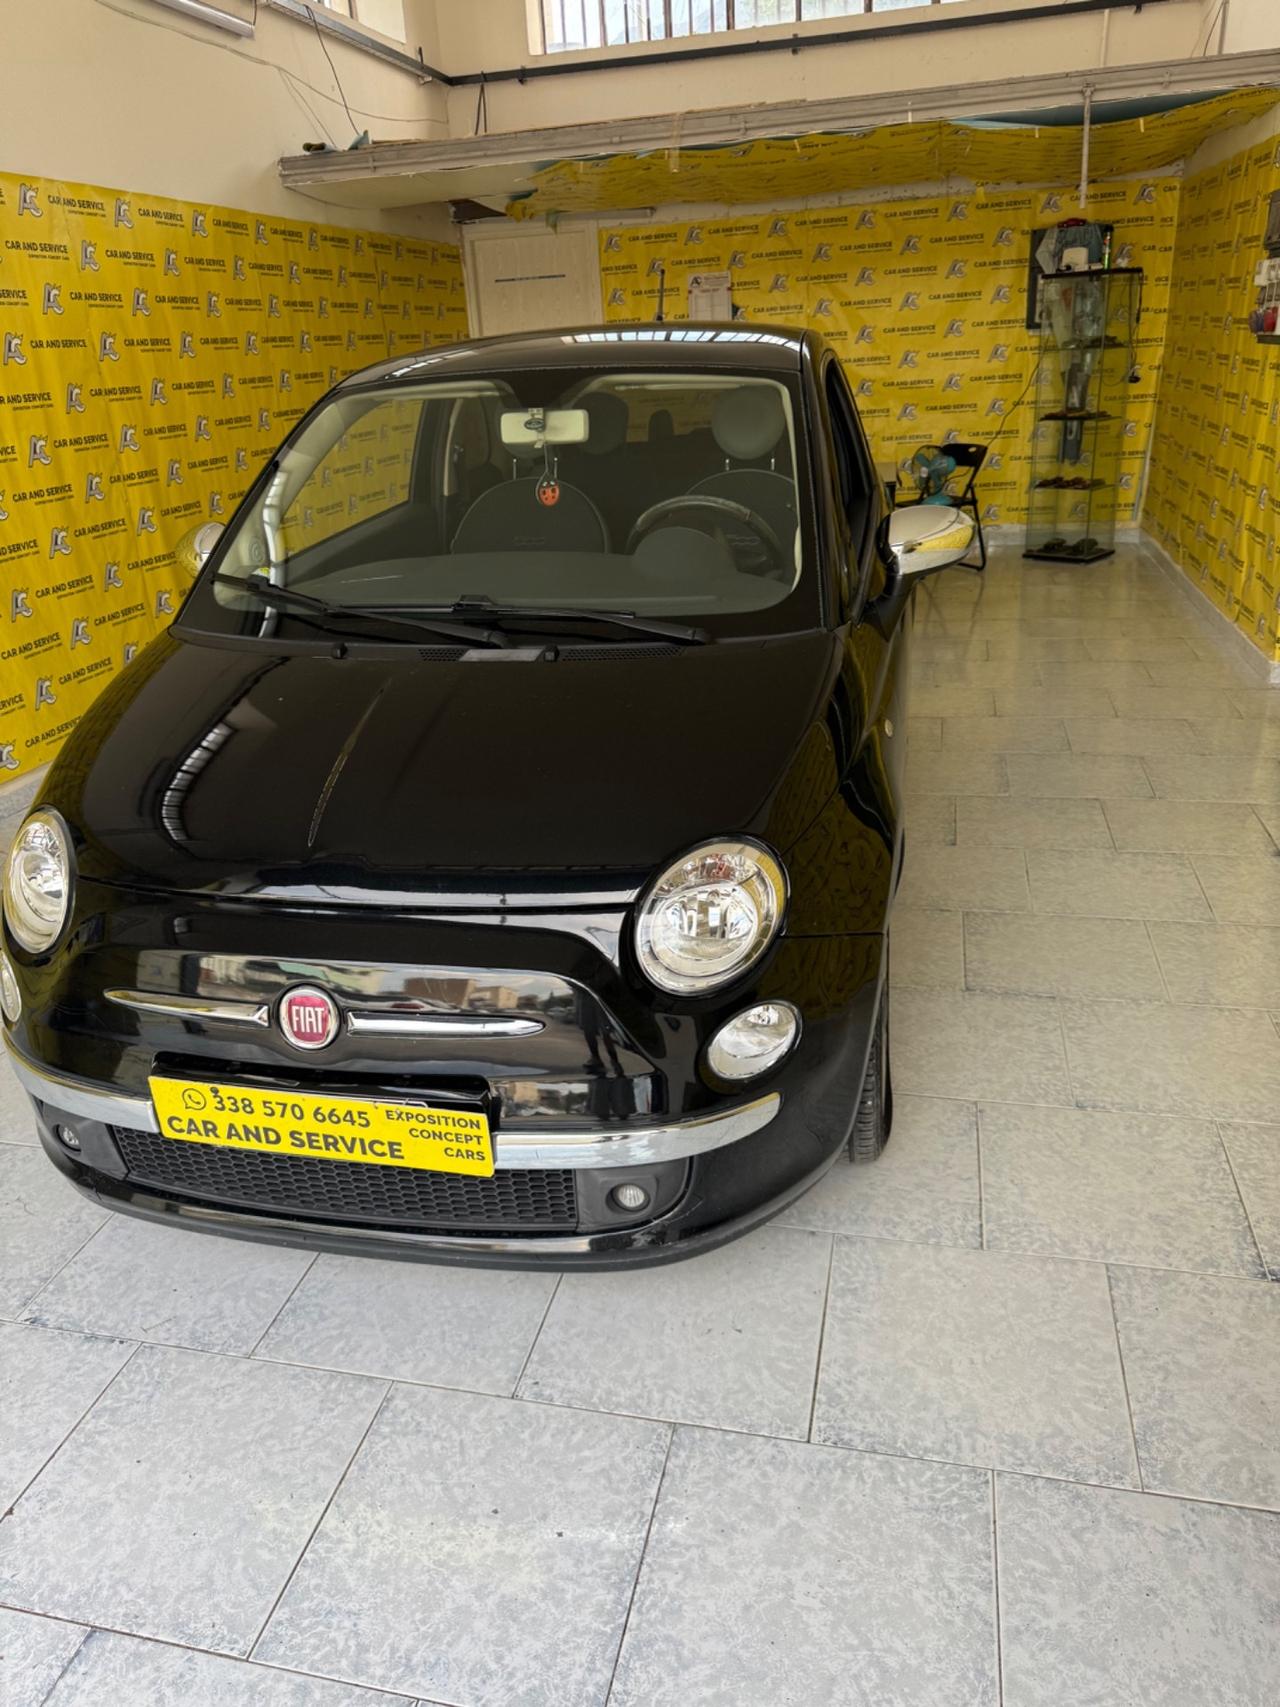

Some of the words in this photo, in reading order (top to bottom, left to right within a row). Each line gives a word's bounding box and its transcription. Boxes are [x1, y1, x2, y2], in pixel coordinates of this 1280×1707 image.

[48, 195, 62, 205] CAR
[62, 197, 76, 208] AND
[77, 199, 105, 211] SERVICE
[976, 202, 989, 210] CAR
[1005, 199, 1031, 207] SERVICE
[138, 208, 150, 217] CAR
[152, 210, 162, 219] AND
[163, 211, 183, 222] SERVICE
[823, 216, 848, 224] SERVICE
[884, 211, 897, 219] CAR
[735, 224, 759, 232] SERVICE
[654, 232, 677, 240] SERVICE
[959, 233, 984, 241] SERVICE
[5, 240, 20, 250] CAR
[23, 242, 38, 251] AND
[39, 243, 68, 254] SERVICE
[868, 241, 892, 249] SERVICE
[105, 249, 117, 258] CAR
[119, 250, 131, 260] AND
[132, 251, 154, 261] SERVICE
[697, 256, 721, 264] SERVICE
[70, 291, 82, 301] CAR
[84, 292, 97, 301] AND
[98, 293, 122, 302] SERVICE
[155, 295, 166, 304] CAR
[167, 296, 178, 304] AND
[179, 296, 199, 304] SERVICE
[867, 297, 891, 305] SERVICE
[30, 340, 43, 349] CAR
[46, 340, 60, 348] AND
[62, 339, 87, 348] SERVICE
[124, 338, 136, 347] CAR
[136, 338, 149, 347] AND
[150, 338, 171, 346] SERVICE
[90, 388, 102, 397] CAR
[104, 387, 117, 396] AND
[118, 385, 142, 395] SERVICE
[172, 383, 183, 391] CAR
[184, 382, 195, 390] AND
[196, 380, 214, 389] SERVICE
[7, 394, 22, 404] AND
[23, 392, 52, 403] SERVICE
[143, 428, 154, 437] CAR
[155, 426, 166, 435] AND
[167, 423, 186, 433] SERVICE
[54, 438, 68, 449] CAR
[69, 437, 82, 447] AND
[84, 433, 108, 444] SERVICE
[109, 474, 121, 484] CAR
[123, 472, 136, 482] AND
[137, 468, 158, 480] SERVICE
[12, 492, 27, 503] CAR
[29, 489, 45, 500] AND
[46, 484, 72, 497] SERVICE
[160, 507, 171, 517] CAR
[172, 505, 182, 514] AND
[183, 500, 201, 512] SERVICE
[74, 527, 86, 538] CAR
[87, 524, 100, 535] AND
[101, 517, 126, 531] SERVICE
[8, 539, 38, 554] SERVICE
[127, 560, 140, 571] CAR
[141, 557, 153, 567] AND
[36, 587, 50, 599] CAR
[52, 582, 66, 595] AND
[68, 574, 93, 590] SERVICE
[94, 615, 106, 627] CAR
[107, 610, 120, 622] AND
[121, 602, 144, 617] SERVICE
[1, 647, 17, 661] CAR
[19, 642, 33, 655] AND
[34, 631, 60, 649] SERVICE
[59, 672, 72, 686] CAR
[73, 667, 86, 680] AND
[87, 656, 112, 674] SERVICE
[25, 735, 39, 749] CAR
[42, 727, 56, 742] AND
[292, 1005, 324, 1033] FIAT
[214, 1092, 254, 1115] 338
[262, 1100, 304, 1122] 570
[313, 1106, 370, 1129] 6645
[386, 1109, 481, 1130] EXPOSITION
[168, 1116, 219, 1139] CAR
[226, 1122, 282, 1146] AND
[290, 1129, 404, 1160] SERVICE
[408, 1128, 484, 1146] CONCEPT
[444, 1146, 486, 1162] CARS
